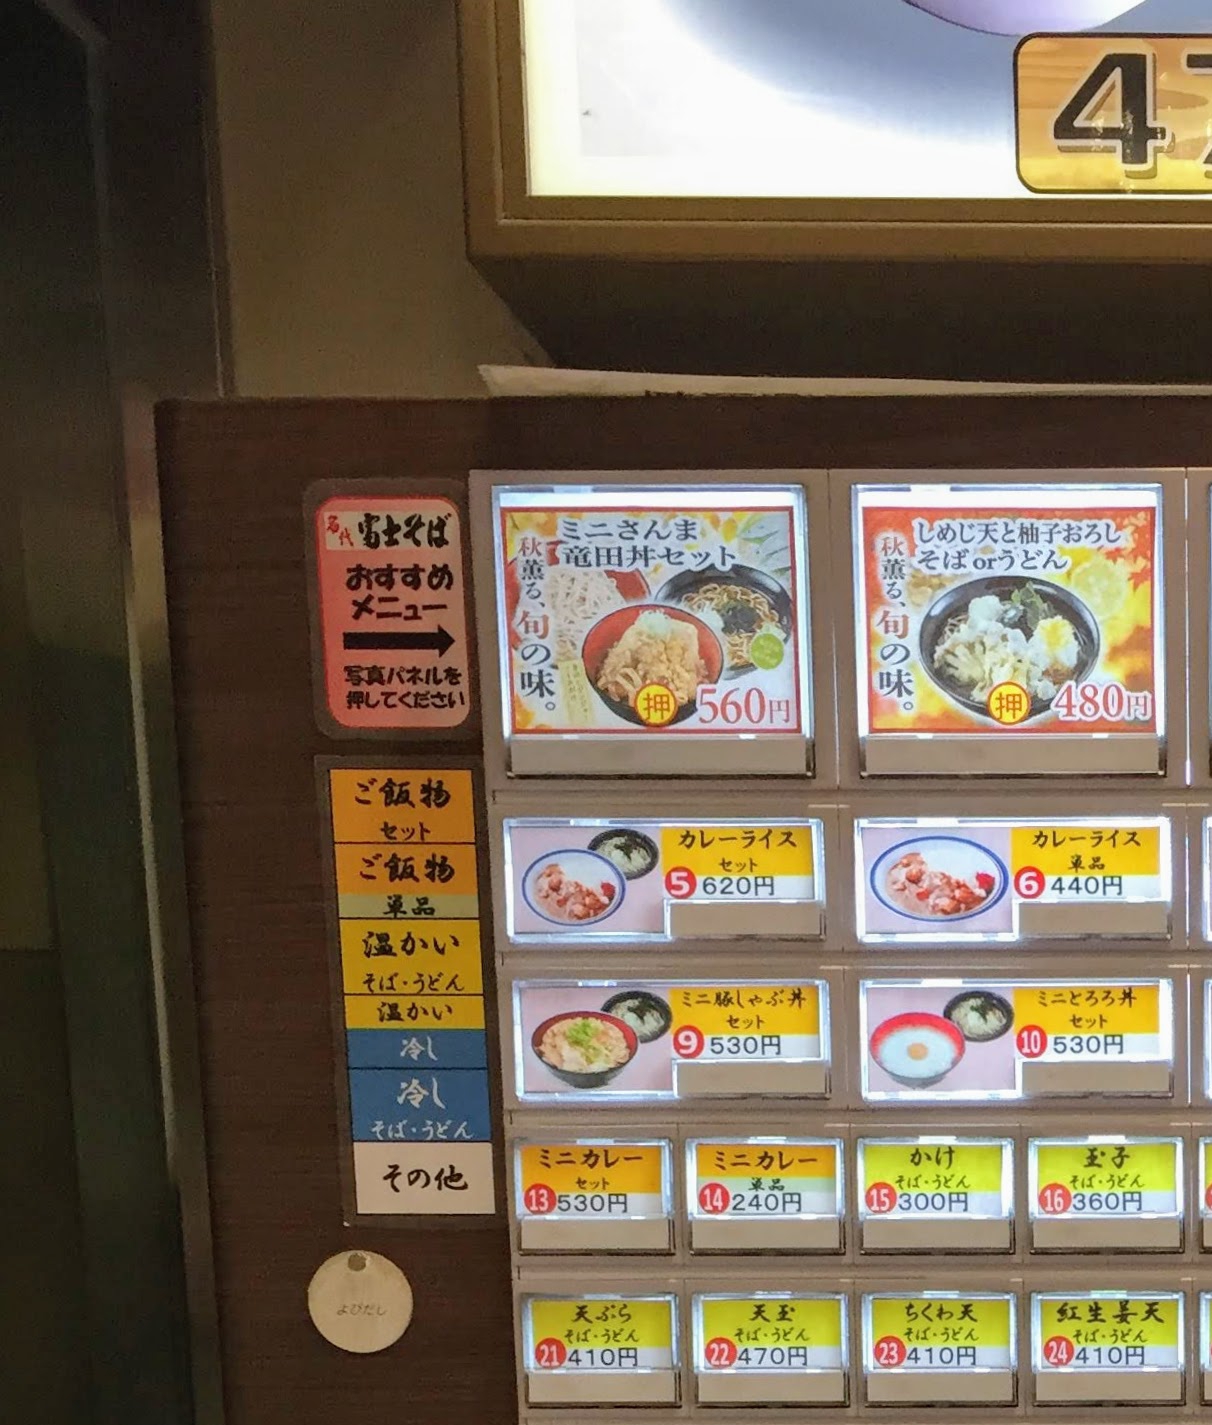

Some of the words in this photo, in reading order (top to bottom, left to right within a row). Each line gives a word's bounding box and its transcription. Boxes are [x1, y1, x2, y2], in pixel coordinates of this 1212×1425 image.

[358, 512, 450, 548] 富士そば
[561, 520, 699, 541] ミニさんま
[916, 522, 1121, 544] しめじ天と柚子おろし
[562, 546, 737, 569] 竜田丼セット
[346, 563, 454, 590] おすすめ
[351, 595, 447, 619] メニュー
[344, 667, 462, 686] 写真パネルを
[346, 691, 466, 709] 押してください
[643, 693, 671, 720] 押
[698, 687, 790, 724] 560円
[995, 693, 1023, 719] 押
[1055, 684, 1149, 720] 480円
[355, 778, 451, 808] ご飯物
[380, 822, 431, 841] セット
[678, 829, 797, 850] カレーライス
[1032, 830, 1141, 848] カレーライス
[360, 853, 455, 883] ご飯物
[718, 857, 759, 872] セット
[1067, 855, 1105, 871] 単品
[702, 876, 775, 896] 620円
[1050, 875, 1122, 896] 440円
[383, 895, 435, 918] 単品
[362, 932, 460, 957] 温かい
[363, 973, 464, 993] そば・うどん
[682, 988, 807, 1009] ミニ豚しゃぶ丼
[1037, 987, 1137, 1007] ミニとろろ丼
[377, 1002, 452, 1022] 温かい
[726, 1014, 765, 1030] セット
[1069, 1014, 1109, 1028] セット
[400, 1037, 439, 1061] 冷し
[710, 1035, 782, 1055] 530円
[1053, 1035, 1124, 1054] 530円
[397, 1078, 446, 1109] 冷し
[538, 1149, 643, 1169] ミニカレー
[714, 1150, 818, 1171] ミニカレー
[910, 1147, 955, 1169] かけ
[1083, 1147, 1130, 1168] 玉子
[383, 1165, 468, 1192] その他
[575, 1177, 610, 1190] セット
[748, 1177, 786, 1191] 単品
[557, 1193, 628, 1213] 530円
[732, 1193, 801, 1212] 240円
[898, 1192, 969, 1212] 300円
[1072, 1191, 1143, 1211] 360円
[336, 1303, 387, 1316] よびだし
[572, 1303, 632, 1323] 天ぷら
[904, 1303, 978, 1322] ちくわ天
[567, 1347, 638, 1367] 410円
[738, 1346, 808, 1366] 470円
[906, 1347, 977, 1366] 410円
[1075, 1347, 1145, 1366] 410円
